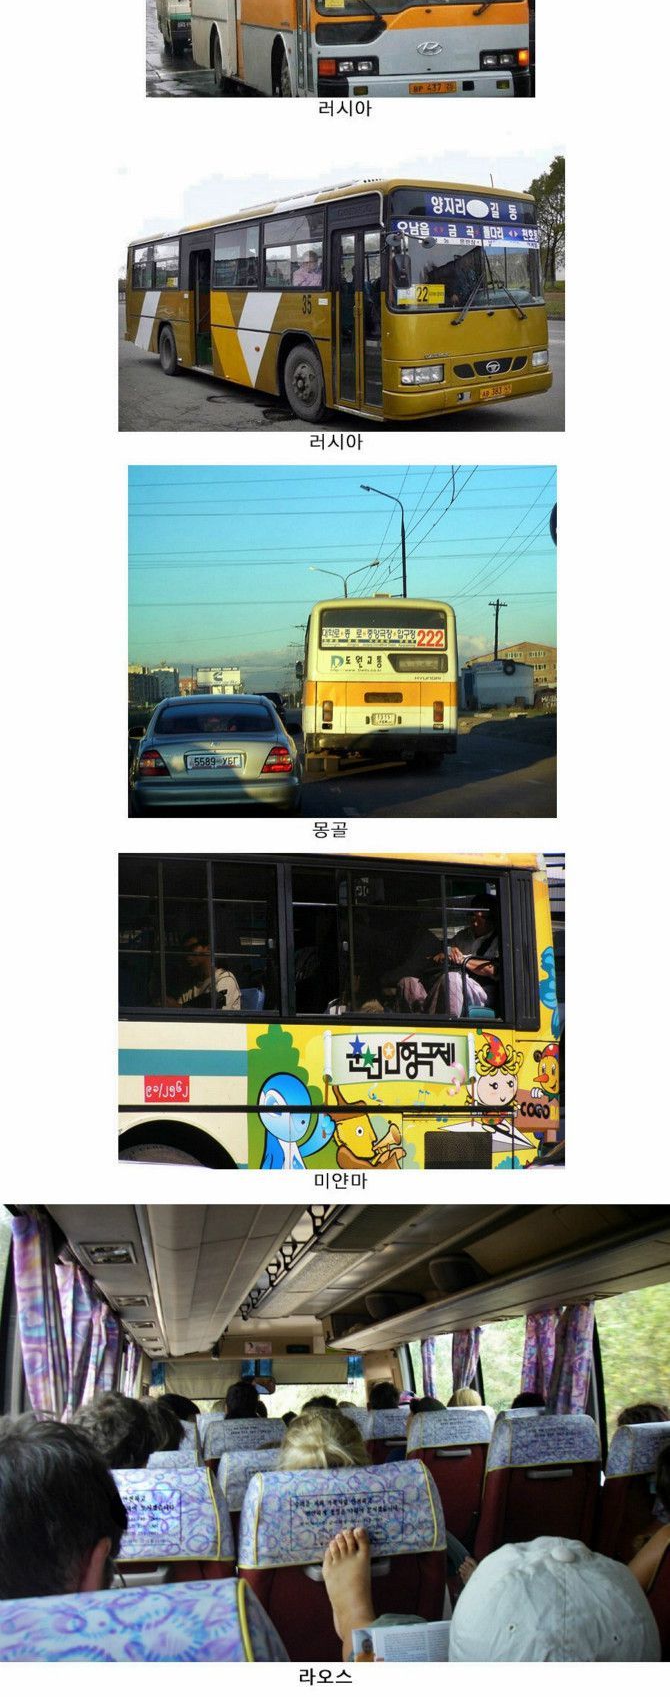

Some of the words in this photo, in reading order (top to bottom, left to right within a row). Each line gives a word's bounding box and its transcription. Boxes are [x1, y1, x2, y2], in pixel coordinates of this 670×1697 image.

[430, 196, 466, 216] 양지리
[397, 221, 430, 236] 오남읍
[416, 286, 429, 302] 22
[302, 294, 312, 314] 35
[417, 630, 444, 647] 222
[194, 757, 216, 766] 5589
